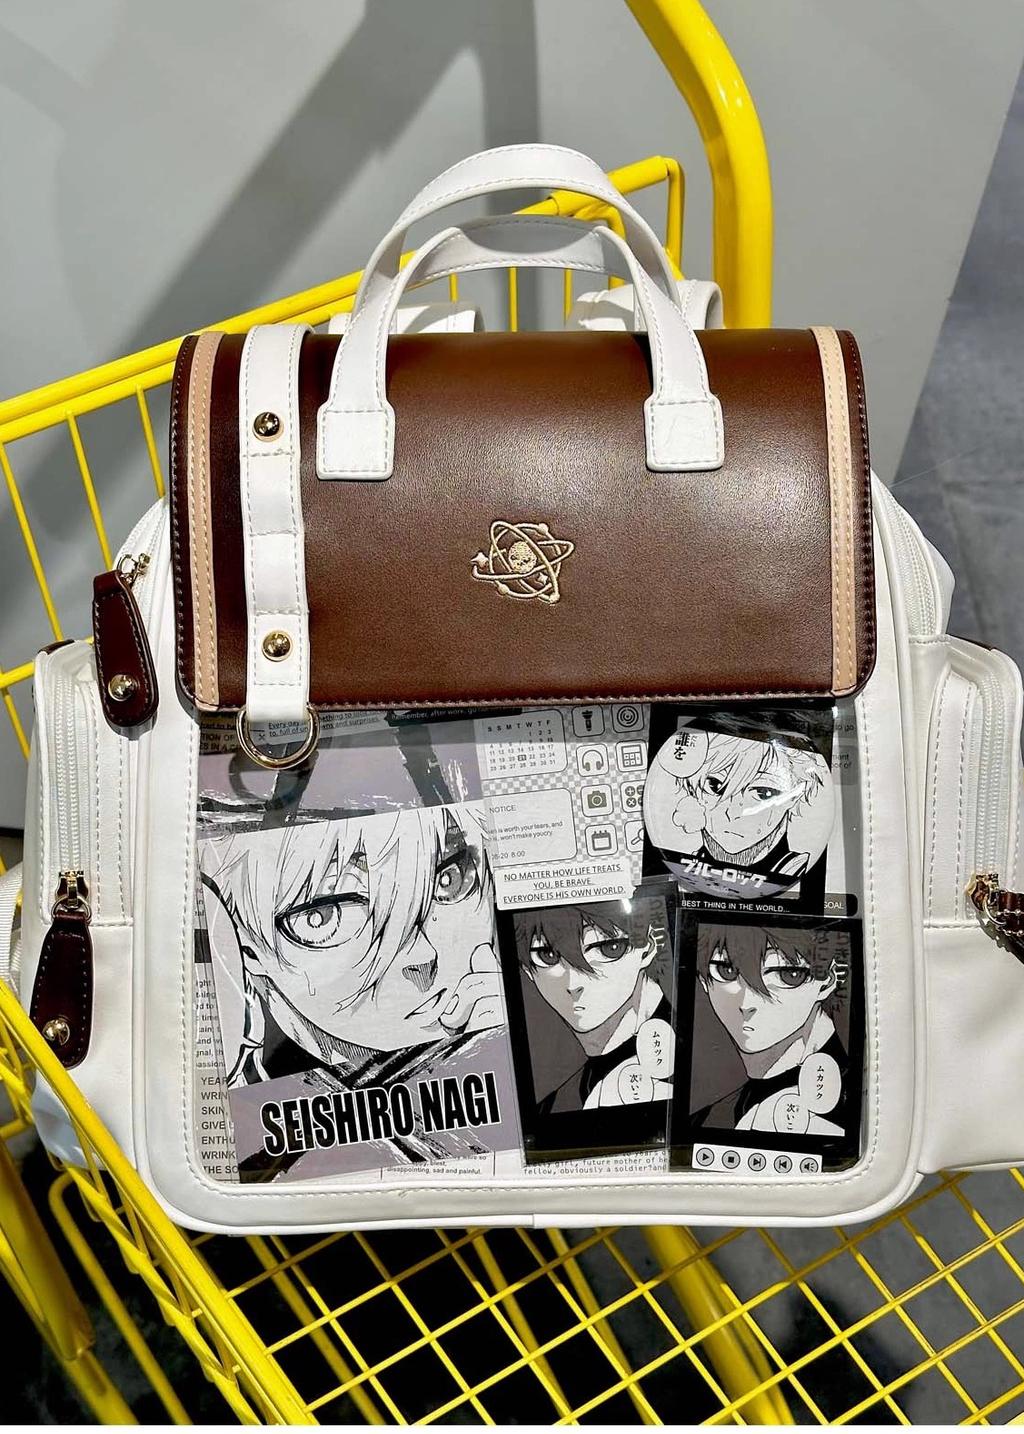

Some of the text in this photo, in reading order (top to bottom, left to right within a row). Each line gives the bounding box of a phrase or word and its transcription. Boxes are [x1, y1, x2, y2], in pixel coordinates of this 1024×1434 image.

[489, 805, 517, 814] NOTICE
[504, 873, 517, 881] NO
[519, 870, 551, 880] MATTER
[552, 868, 574, 877] HOW
[575, 866, 591, 875] LIFE
[680, 858, 768, 889] ブルーロック
[554, 880, 565, 888] BE
[503, 894, 544, 904] EVERYONE
[555, 891, 569, 899] HIS
[570, 889, 592, 898] OWN
[681, 900, 701, 908] BEST
[703, 901, 727, 910] THING
[739, 903, 754, 911] THE
[652, 1030, 663, 1067] ムカツク
[815, 1064, 825, 1101] ムカツク
[260, 1070, 502, 1158] SEISHIRO NAGI
[201, 1121, 226, 1130] GIVE
